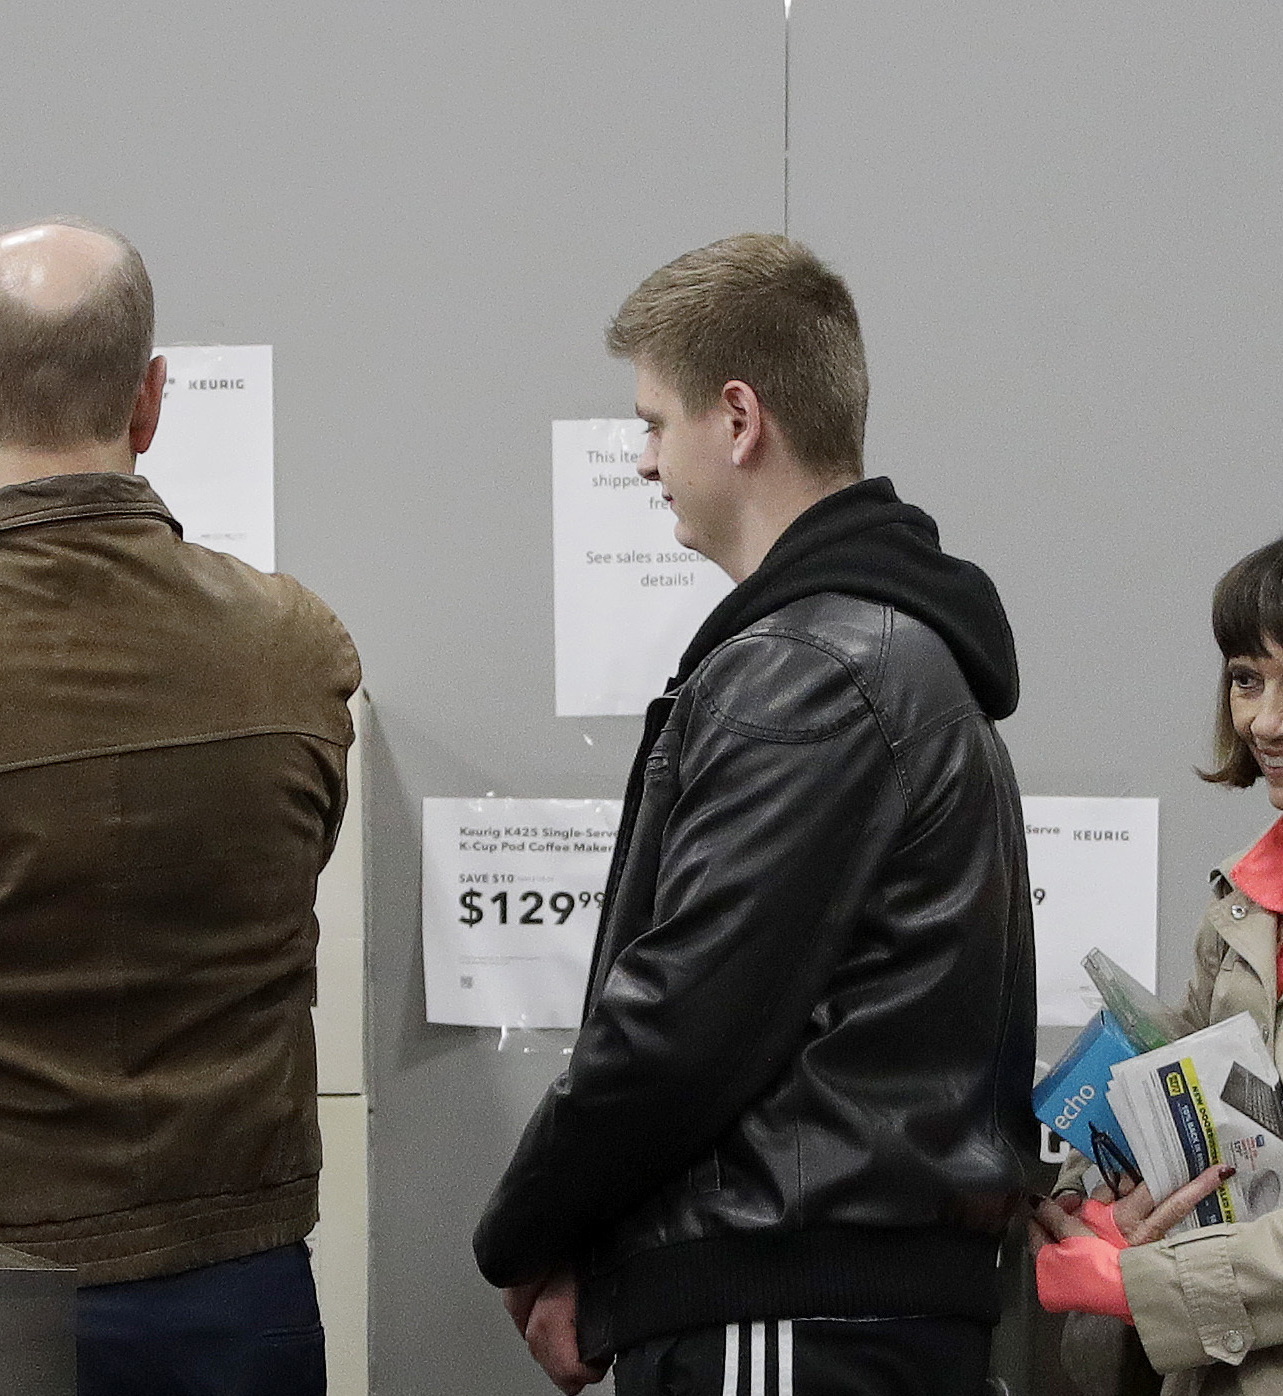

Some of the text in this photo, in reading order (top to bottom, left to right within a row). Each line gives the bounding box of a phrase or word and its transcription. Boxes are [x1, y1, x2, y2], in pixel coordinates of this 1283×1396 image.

[189, 379, 245, 389] KEURIG
[586, 451, 640, 463] This ite
[586, 550, 707, 564] See sales associa
[641, 574, 694, 587] details!
[459, 826, 500, 838] Keurig
[504, 827, 538, 837] K425
[1073, 830, 1130, 841] KEURIG
[459, 841, 613, 852] K-Cup Pod Coffee Maker
[459, 874, 488, 883] SAVE
[492, 874, 514, 883] $10
[1192, 1086, 1203, 1106] NEW
[1053, 1081, 1096, 1130] echo
[1188, 1119, 1199, 1144] BACK
